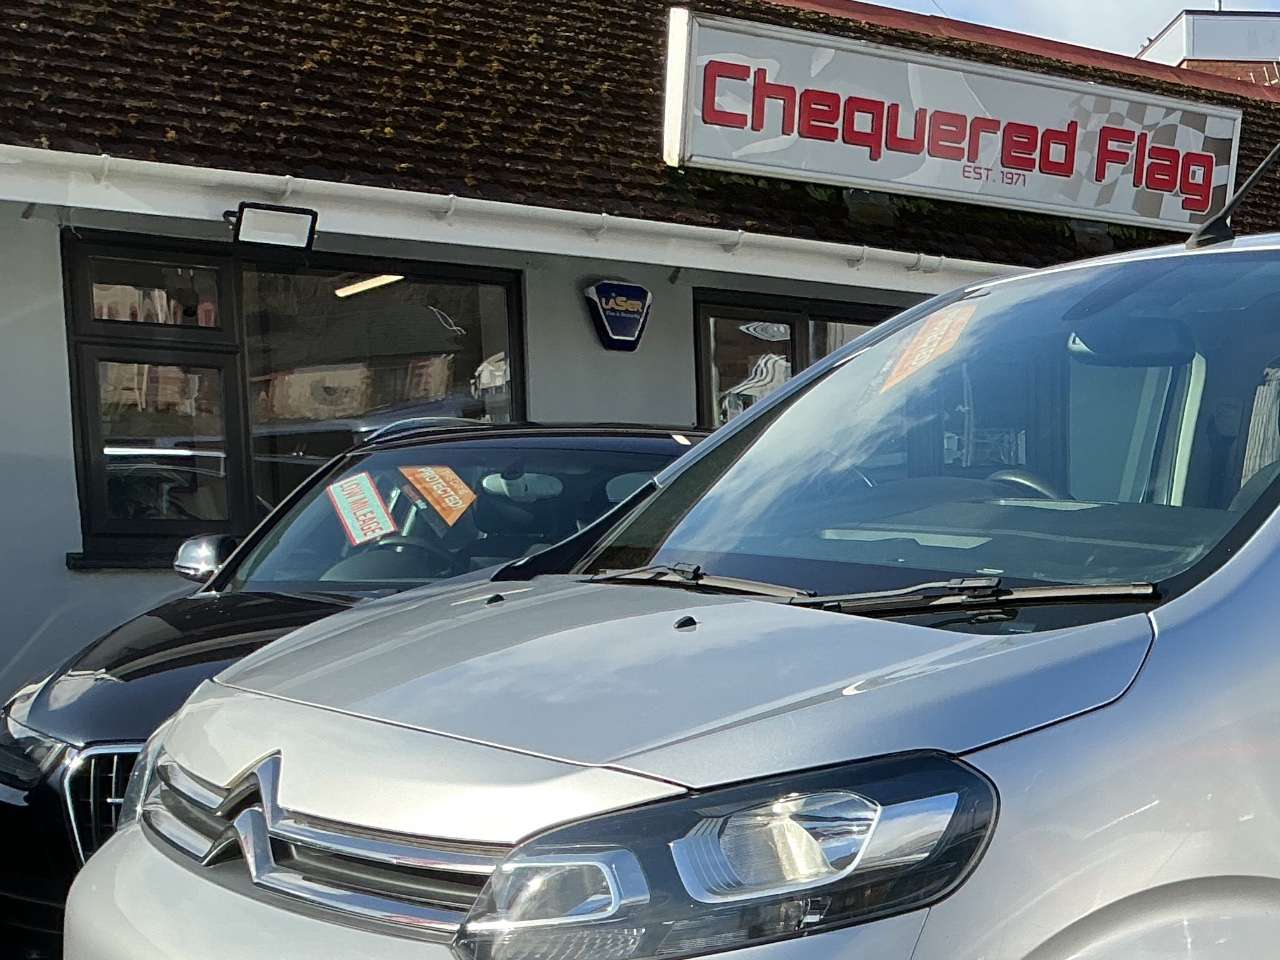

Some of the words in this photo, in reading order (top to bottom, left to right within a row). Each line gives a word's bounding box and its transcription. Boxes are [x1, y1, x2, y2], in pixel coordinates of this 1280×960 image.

[702, 59, 1079, 178] Chequered
[1095, 124, 1215, 215] Flag
[962, 164, 996, 183] EST.
[1000, 170, 1027, 187] 1971
[339, 479, 364, 500] LOW
[350, 495, 384, 537] MILEAGE
